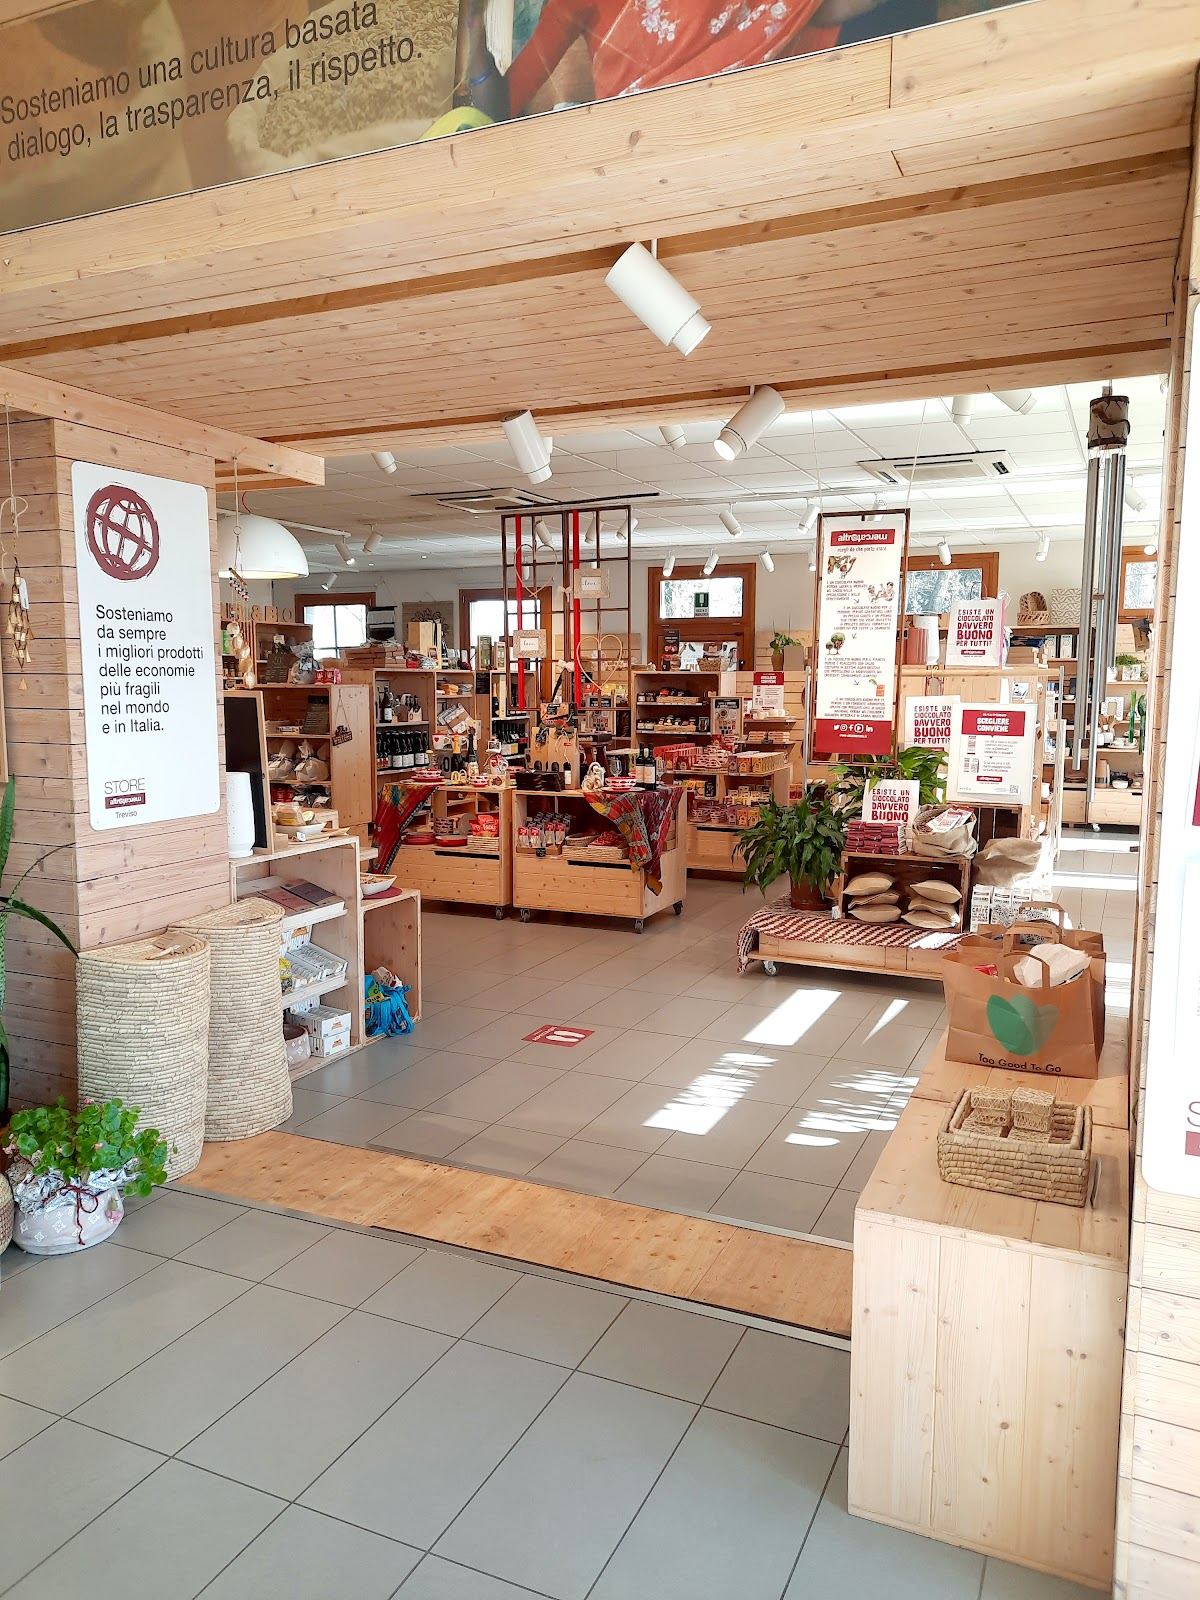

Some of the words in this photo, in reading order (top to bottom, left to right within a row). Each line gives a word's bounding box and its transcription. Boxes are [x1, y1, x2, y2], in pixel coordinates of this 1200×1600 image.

[1, 69, 130, 125] Sosteniamo
[138, 56, 183, 89] una
[190, 29, 276, 73] cultura
[284, 0, 379, 49] basata
[7, 123, 91, 162] dialogo,
[99, 111, 120, 140] la
[126, 73, 279, 133] trasparenza,
[288, 59, 301, 91] il
[310, 34, 423, 86] rispetto.
[96, 604, 174, 624] Sosteniamo
[97, 625, 115, 640] da
[118, 626, 167, 642] sempre
[957, 622, 994, 630] DAVVERO
[957, 630, 993, 640] BUONO
[97, 643, 102, 658] i
[105, 645, 154, 662] migliori
[157, 646, 204, 663] prodotti
[99, 663, 132, 678] delle
[135, 665, 195, 678] economie
[100, 682, 121, 700] più
[124, 681, 161, 699] fragili
[101, 700, 121, 716] nel
[126, 698, 170, 714] mondo
[102, 721, 110, 734] e
[114, 719, 127, 734] in
[130, 717, 165, 734] Italia.
[914, 719, 951, 727] DAVVERO
[914, 727, 951, 737] BUONO
[104, 777, 146, 795] STORE
[115, 811, 138, 819] Treviso
[872, 802, 909, 811] DAVVERO
[871, 811, 909, 822] BUONO
[978, 1052, 995, 1065] Too
[998, 1058, 1027, 1070] Good
[1031, 1063, 1042, 1071] To
[1045, 1064, 1062, 1073] Go
